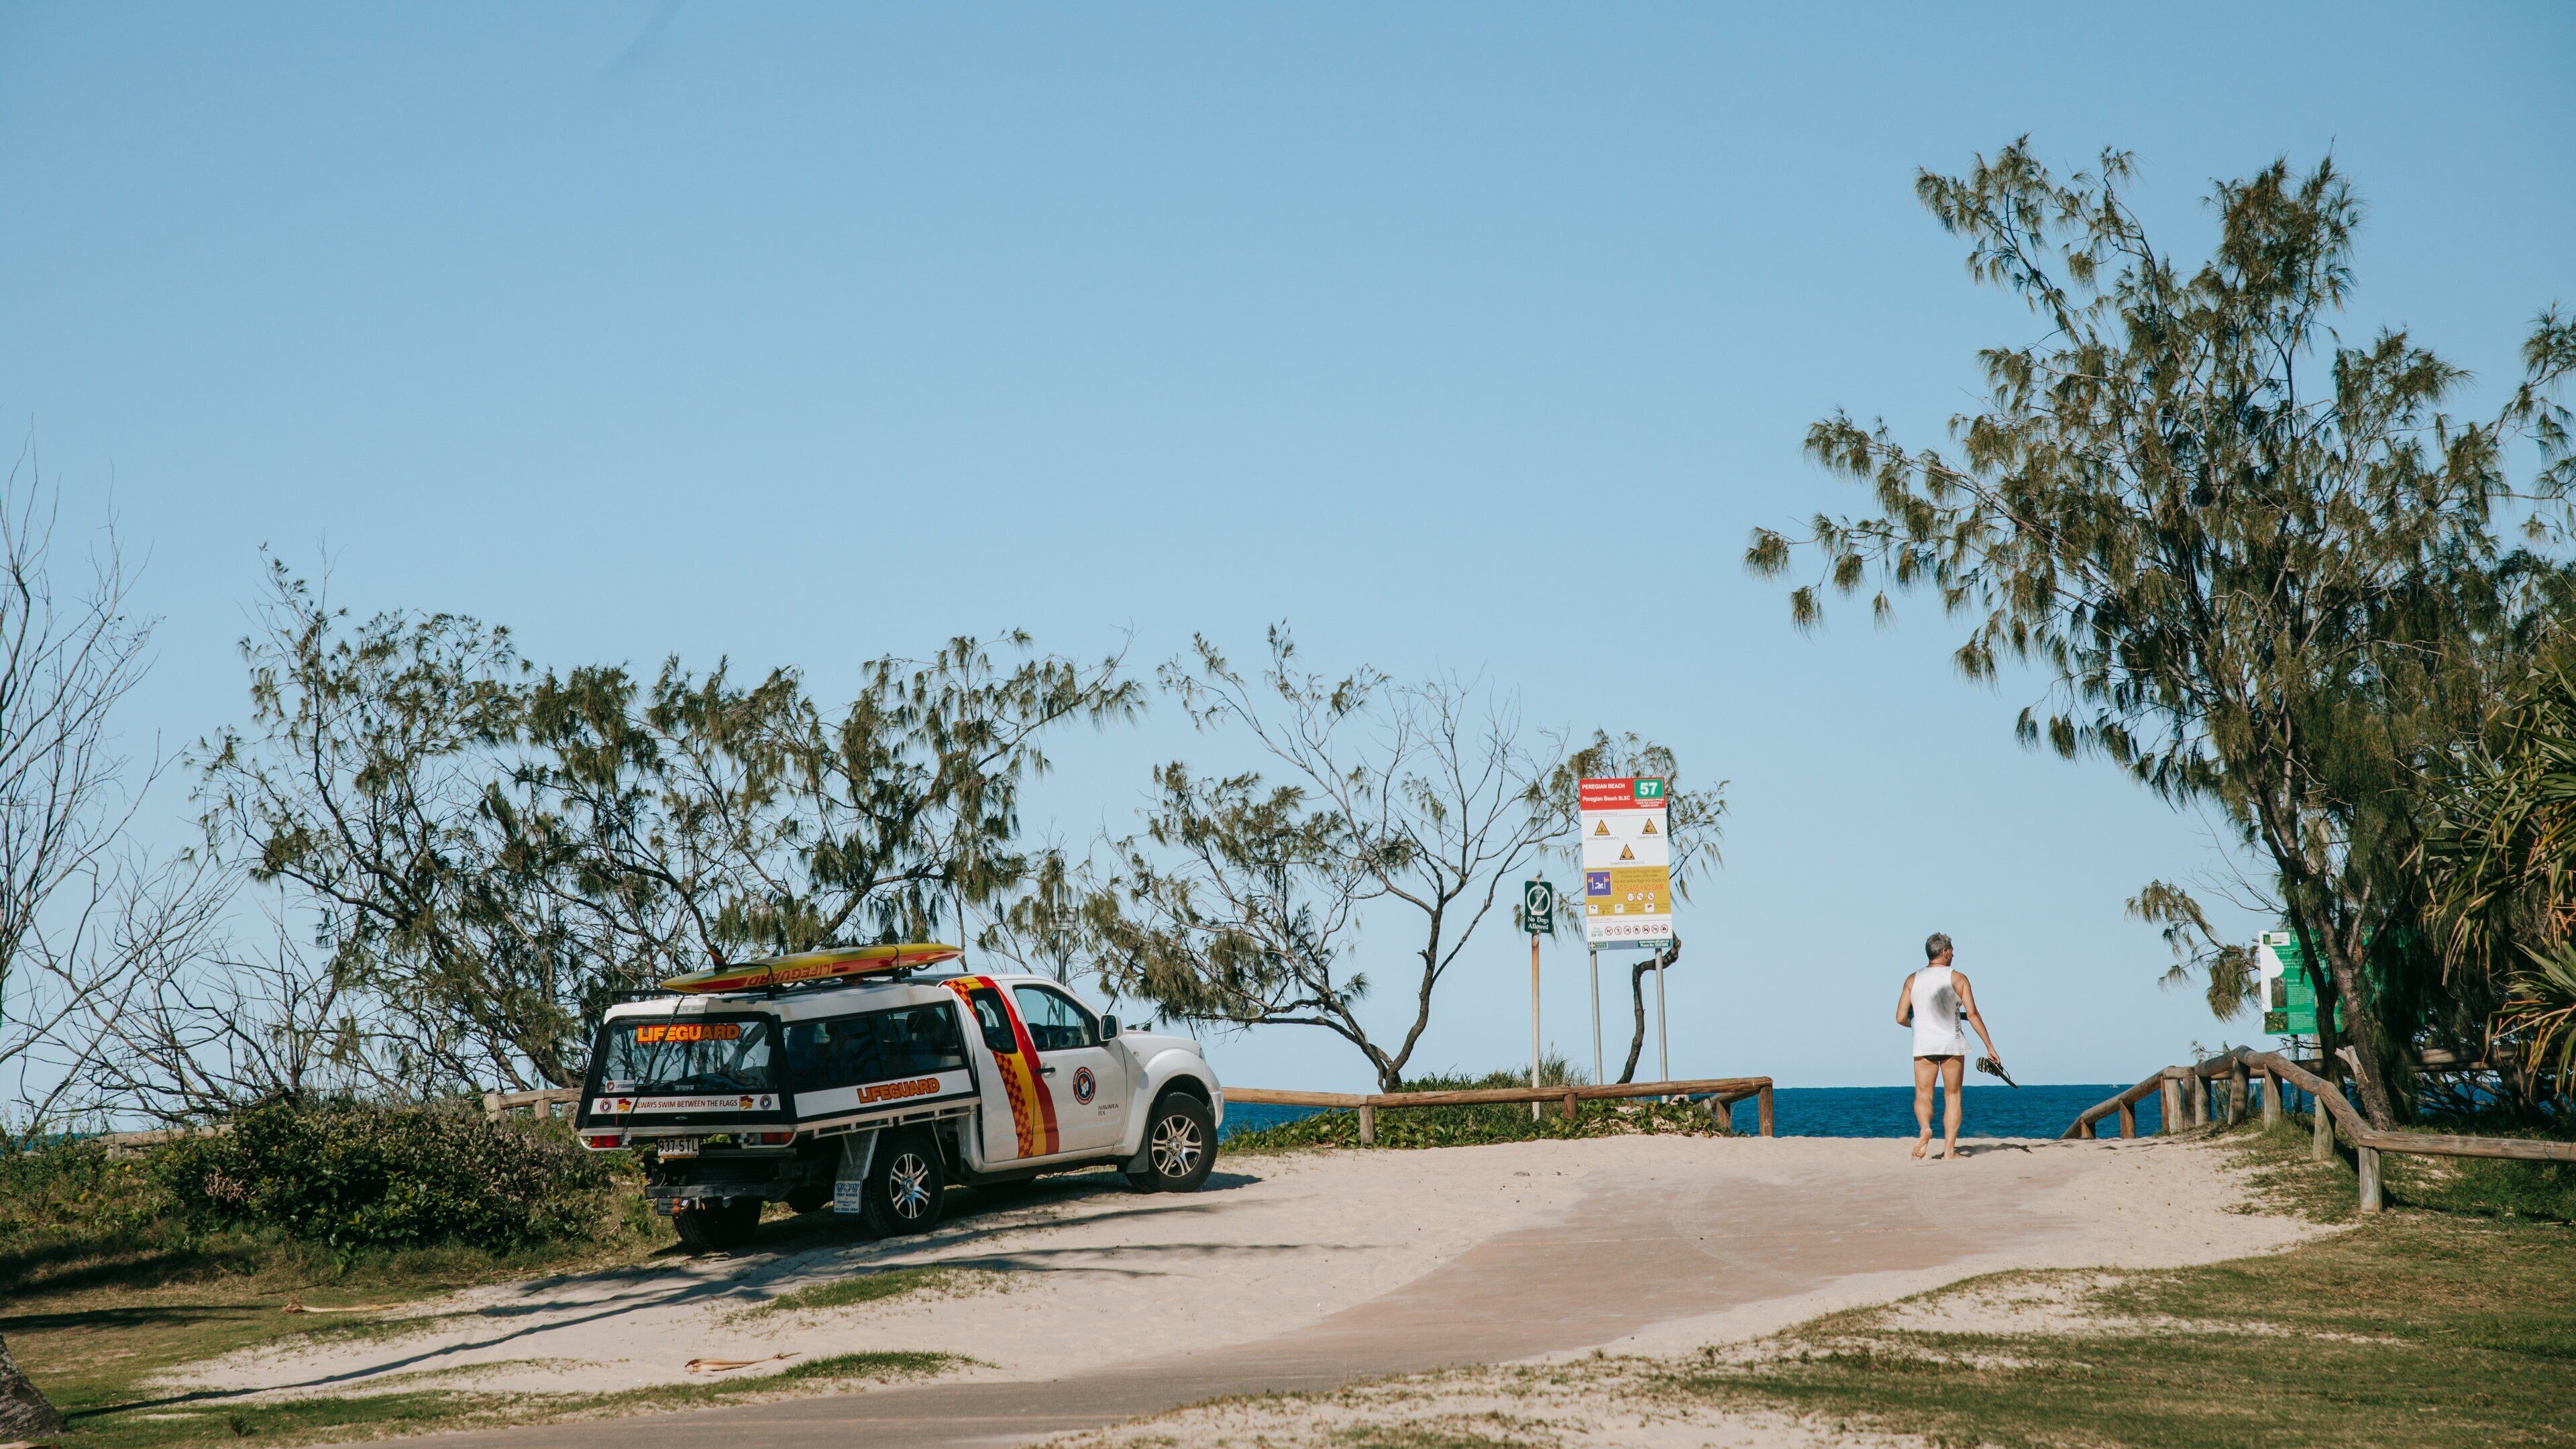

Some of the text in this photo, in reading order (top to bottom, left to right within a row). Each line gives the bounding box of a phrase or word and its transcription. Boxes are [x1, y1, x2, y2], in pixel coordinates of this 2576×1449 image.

[1640, 782, 1658, 795] 57
[1537, 916, 1549, 924] Dogs
[746, 964, 832, 985] LIFEGUARD
[637, 1024, 741, 1043] LIFEGUARD
[857, 1077, 940, 1104] LIFEGUARD
[677, 1099, 705, 1108] BETWEEN
[706, 1099, 718, 1107] THE
[719, 1098, 737, 1107] FLAGS
